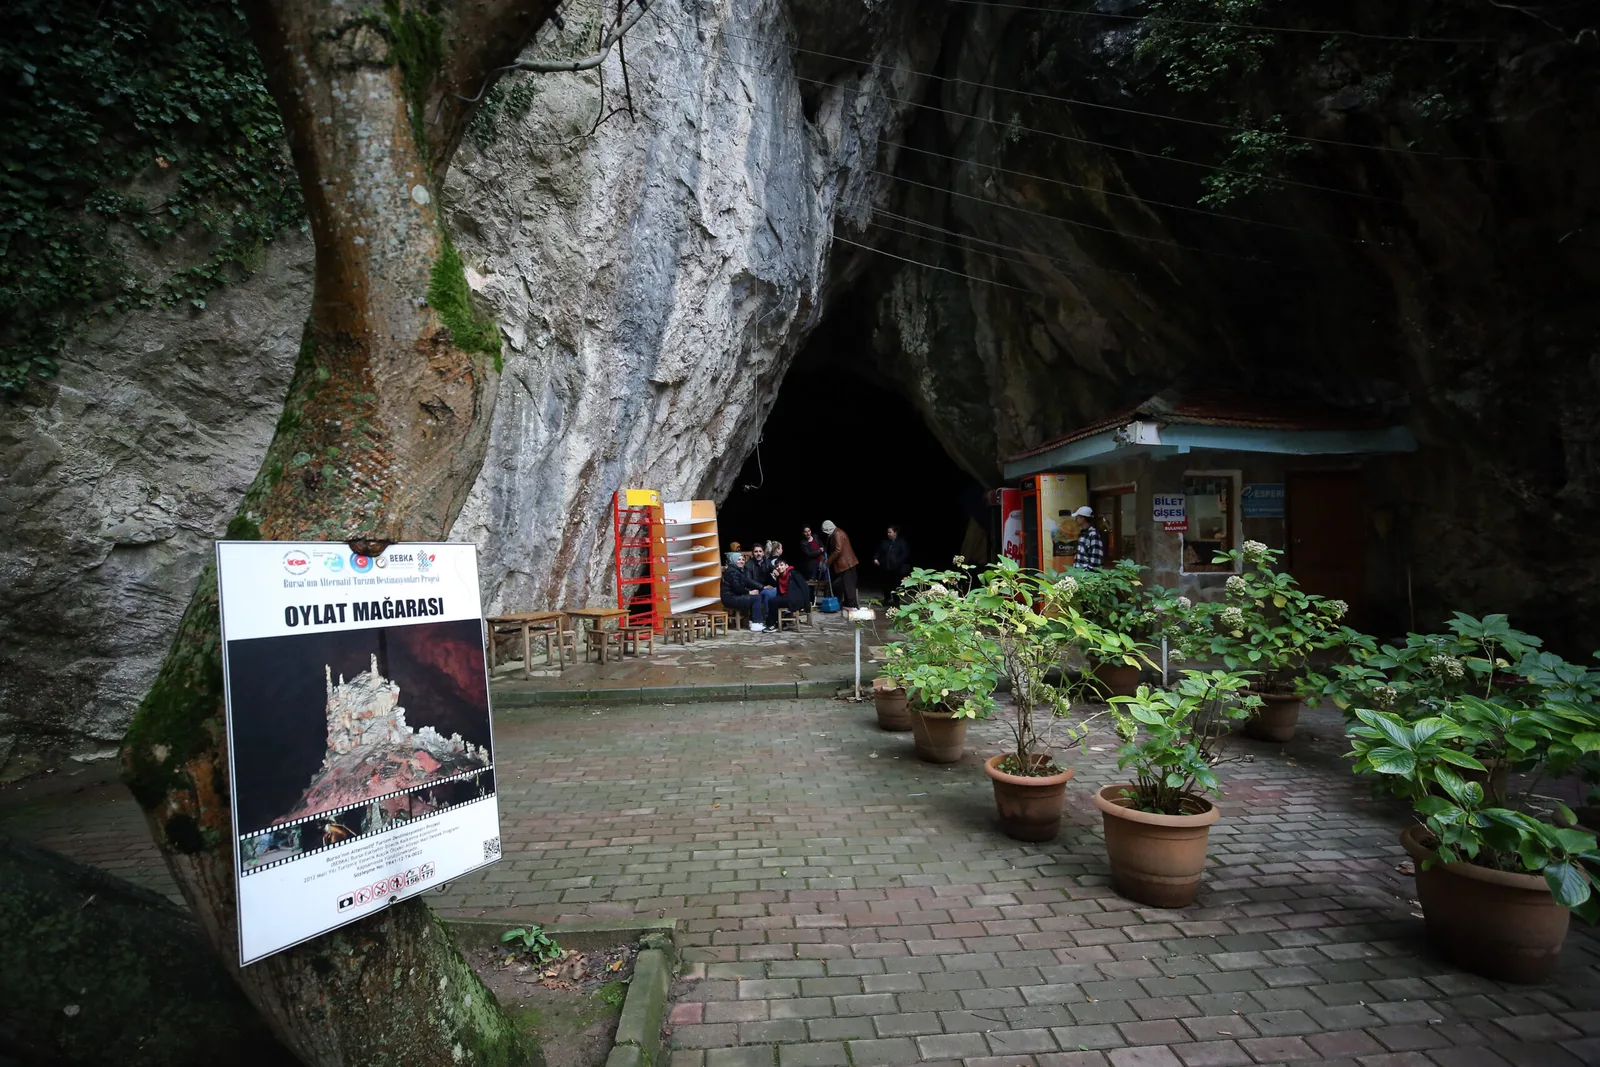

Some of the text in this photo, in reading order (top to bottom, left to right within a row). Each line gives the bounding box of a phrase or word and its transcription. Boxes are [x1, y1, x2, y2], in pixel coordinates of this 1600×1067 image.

[1154, 496, 1184, 506] BİLET
[1153, 507, 1186, 518] GİŞESİ
[390, 554, 414, 562] BEBKA
[283, 578, 318, 588] Bursa'nın
[320, 576, 351, 587] Alternatif
[353, 575, 376, 585] Turizm
[285, 596, 445, 628] OYLAT MAĞARASI
[303, 875, 315, 883] 2012
[421, 871, 434, 879] 177
[406, 877, 419, 885] 156
